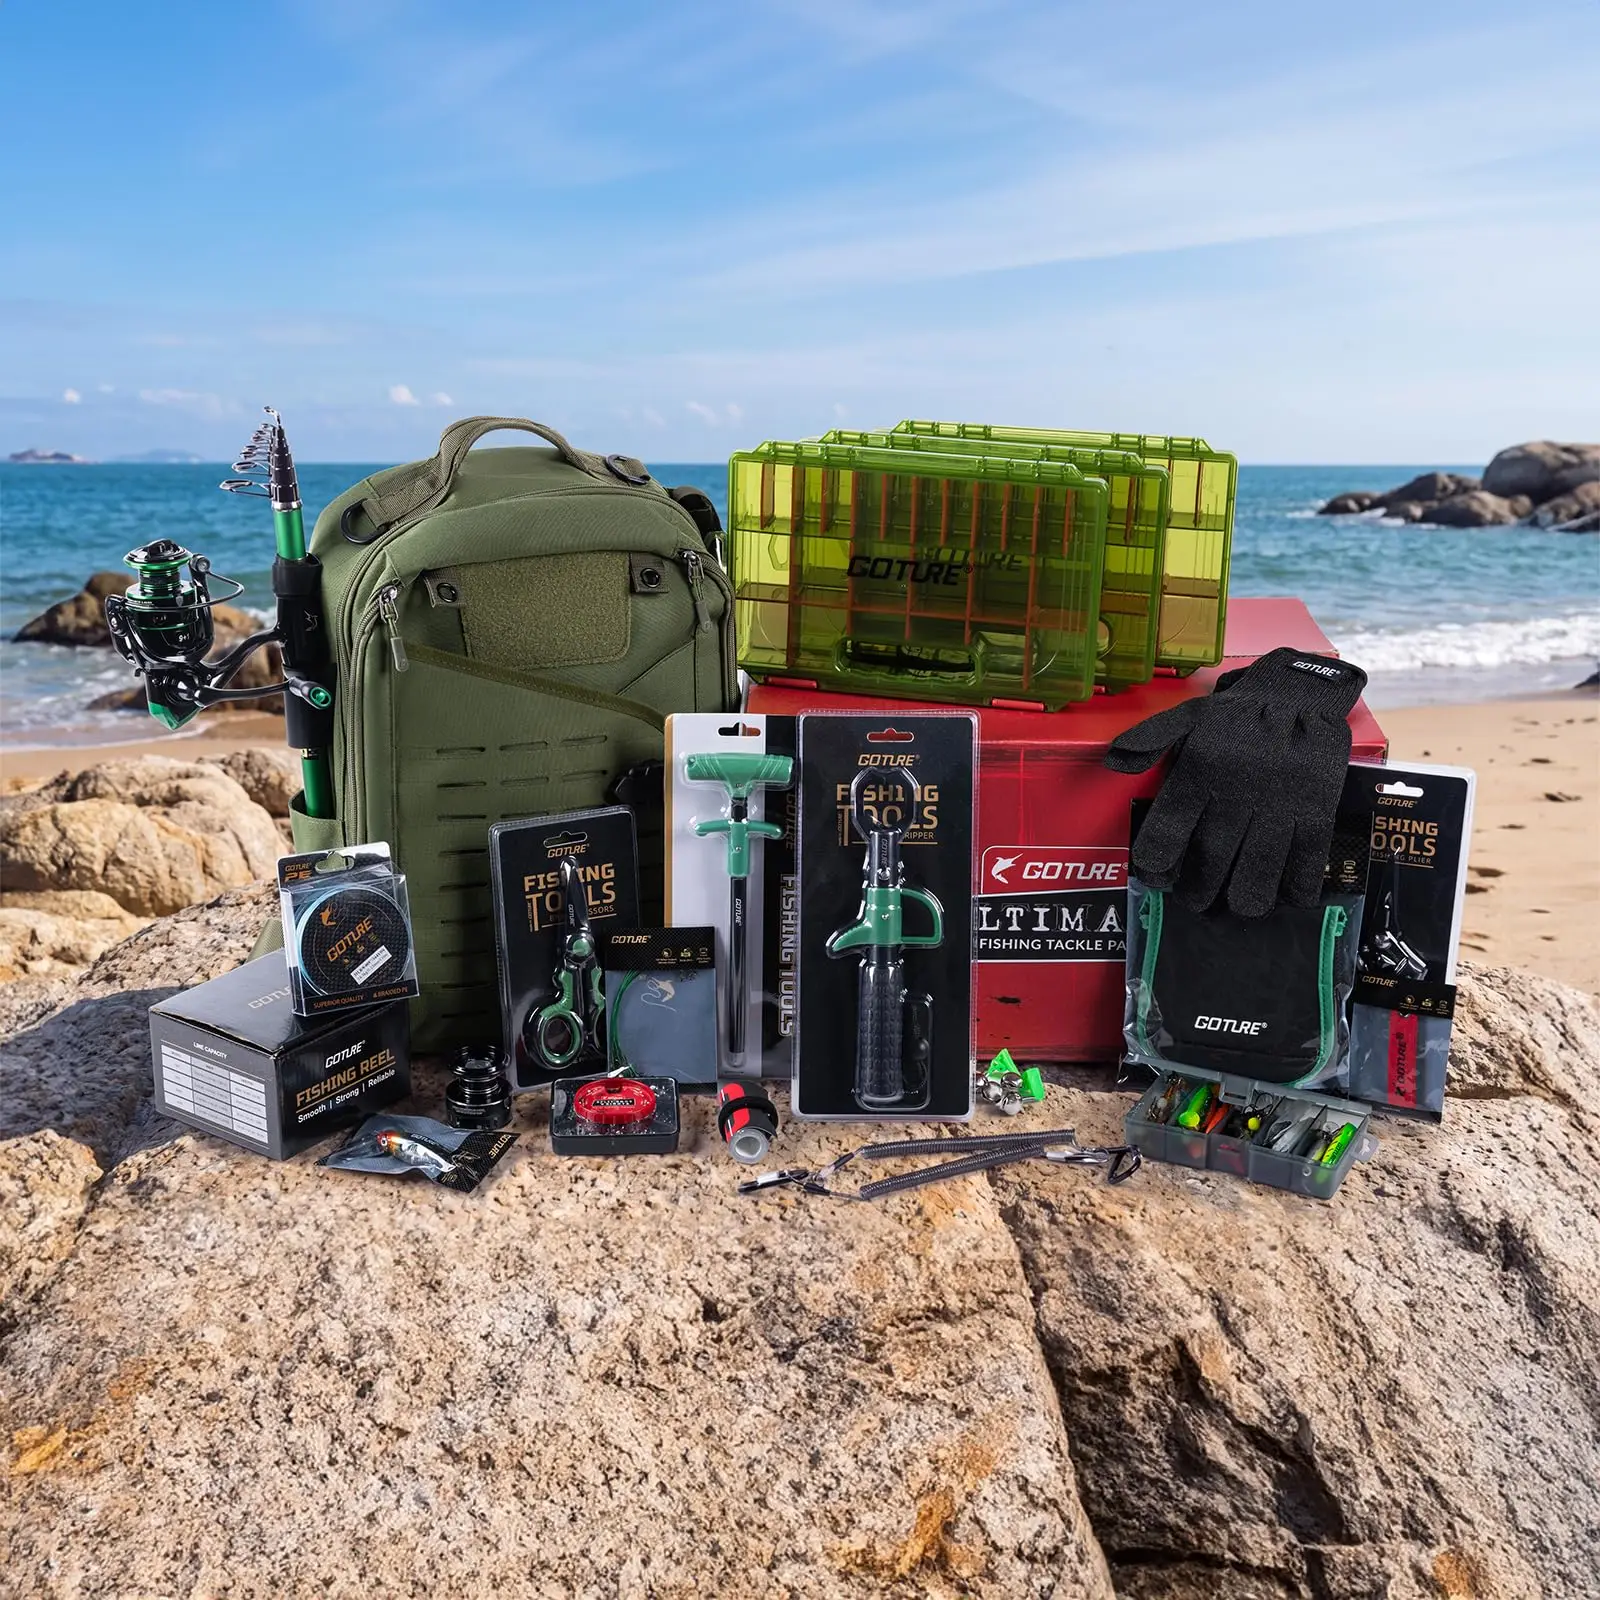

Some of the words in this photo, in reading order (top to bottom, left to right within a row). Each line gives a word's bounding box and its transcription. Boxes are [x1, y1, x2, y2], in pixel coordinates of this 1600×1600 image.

[846, 555, 965, 586] GOTURE
[1293, 661, 1336, 677] GOTURE
[858, 754, 915, 766] GOTURE
[1377, 797, 1415, 808] GOTURE
[547, 845, 587, 858] GOTURE
[1408, 855, 1432, 865] PLIER
[285, 870, 312, 882] PE
[523, 863, 616, 892] FISING
[1022, 862, 1122, 880] GOTURE
[525, 881, 616, 932] TOLS
[781, 875, 797, 962] FISHING
[327, 915, 373, 961] GOTURE
[611, 935, 648, 944] GOTURE
[979, 938, 1041, 950] FISHING
[1046, 939, 1102, 951] TACKLE
[1362, 975, 1396, 988] GOTURE
[779, 972, 796, 1037] TOOLS
[1194, 1015, 1262, 1036] GOTURE
[193, 1042, 204, 1051] LINE
[204, 1046, 228, 1059] CAPACITY
[325, 1041, 362, 1069] GOTURE
[296, 1066, 356, 1107] FISHING
[360, 1048, 395, 1075] REEL
[298, 1104, 327, 1123] Smooth
[335, 1087, 360, 1104] Strong
[368, 1069, 395, 1088] Reliable
